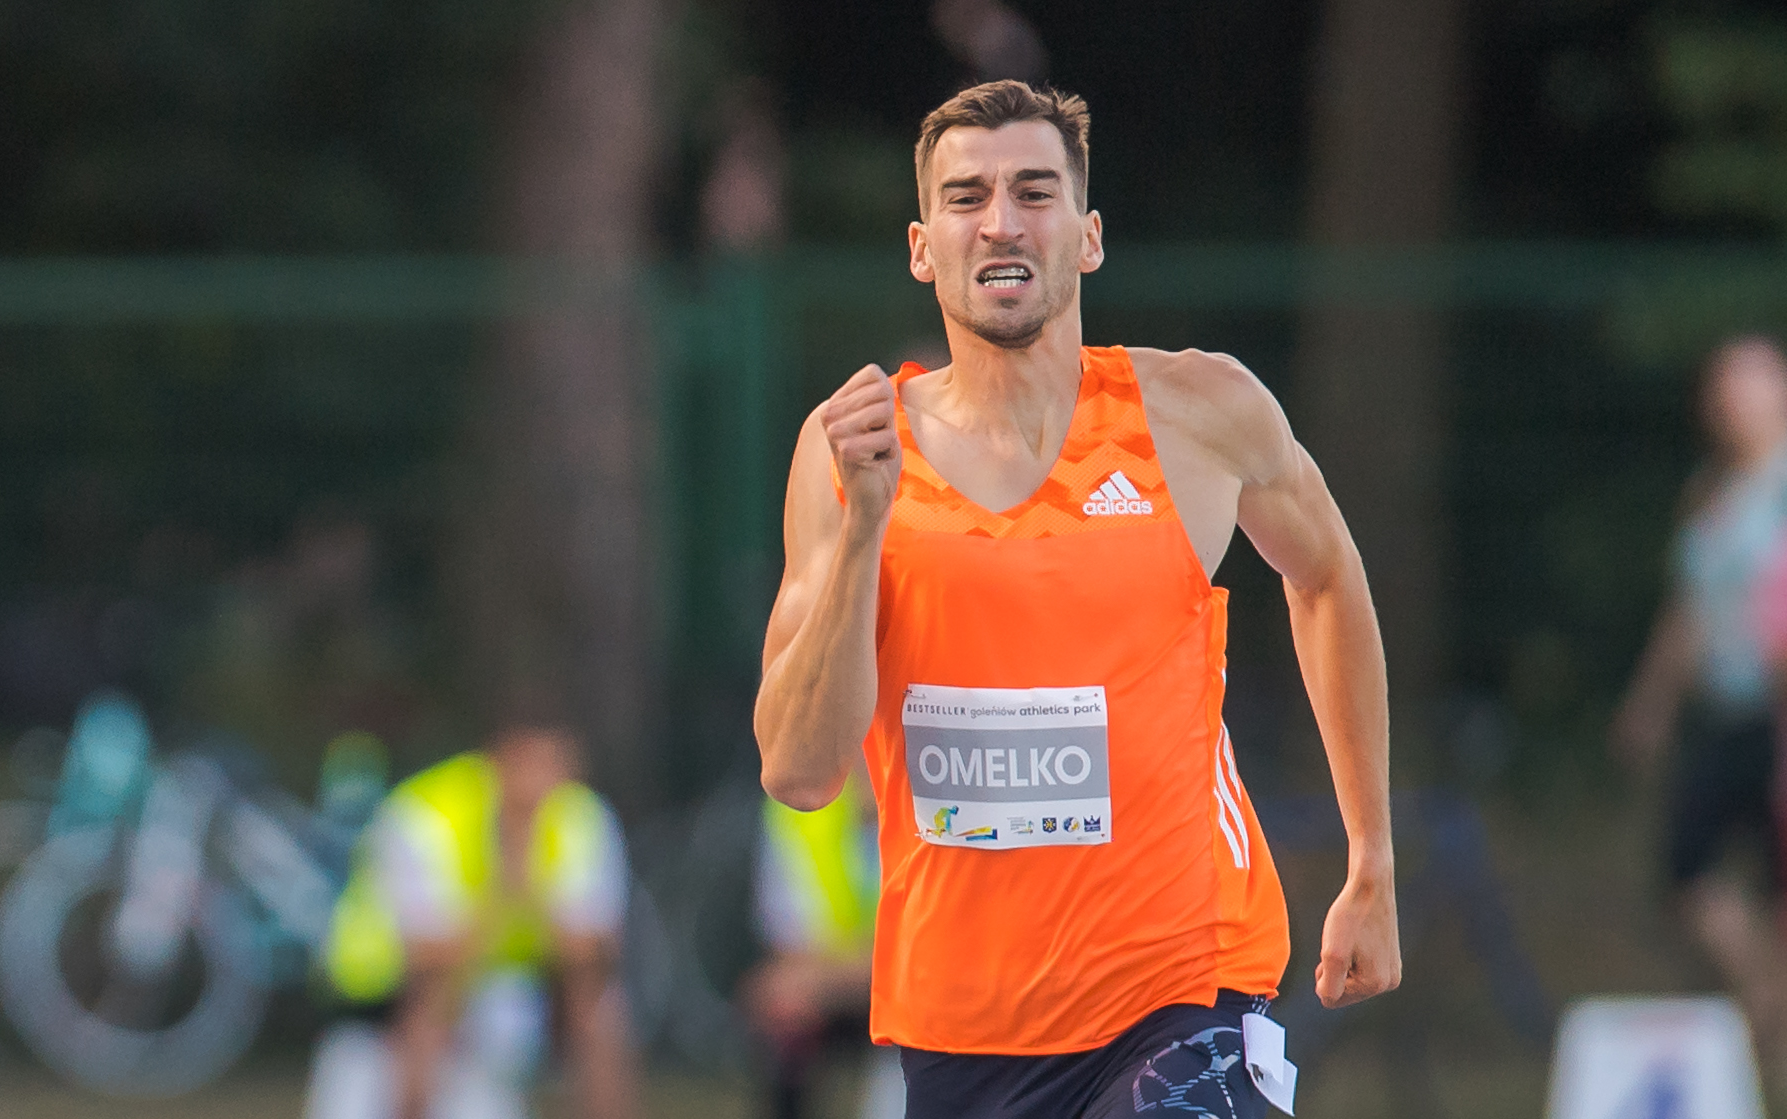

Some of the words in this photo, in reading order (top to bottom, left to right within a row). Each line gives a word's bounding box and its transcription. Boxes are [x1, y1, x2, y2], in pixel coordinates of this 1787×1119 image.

[1082, 499, 1153, 515] adidas
[907, 703, 967, 715] BESTSELLER
[1019, 704, 1070, 716] athletics
[1074, 703, 1101, 716] park
[919, 744, 1091, 787] OMELKO
